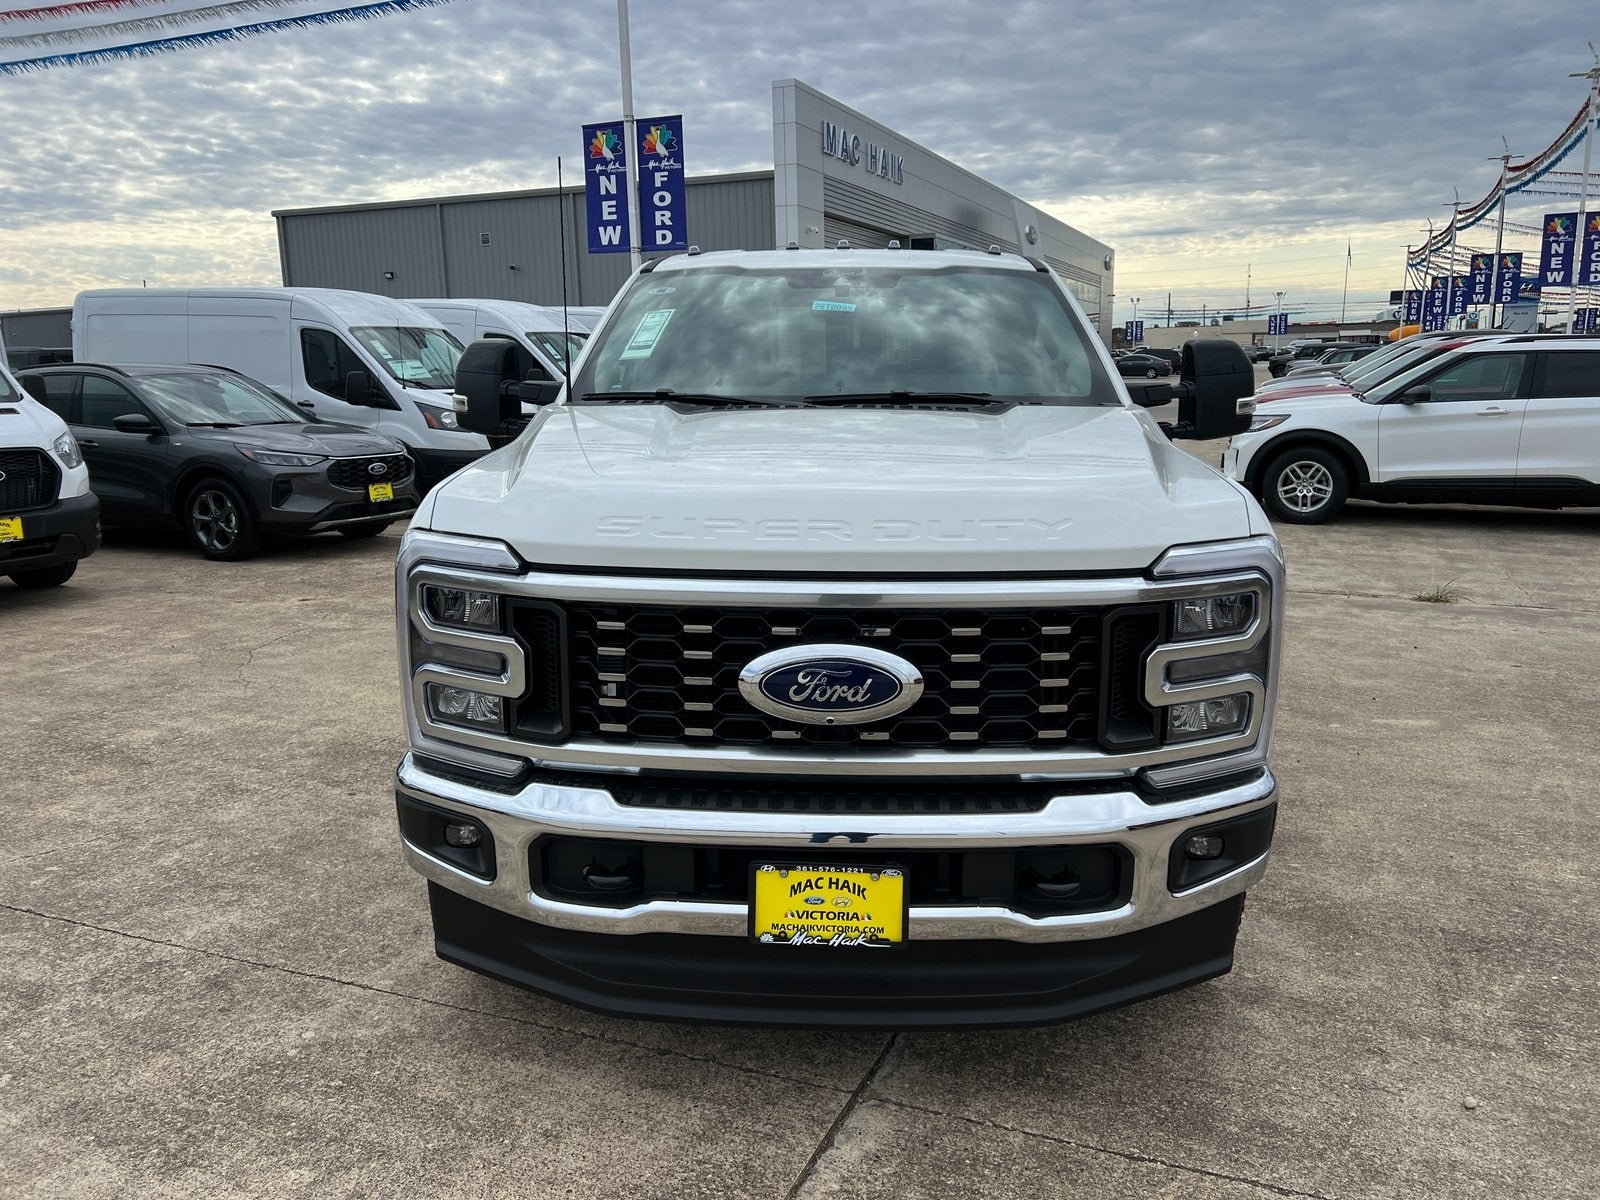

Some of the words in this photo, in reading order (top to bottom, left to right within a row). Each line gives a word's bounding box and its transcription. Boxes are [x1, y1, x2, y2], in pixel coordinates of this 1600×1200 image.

[822, 120, 861, 166] MAC
[866, 141, 905, 185] HAIK
[598, 174, 622, 246] NEW
[652, 171, 673, 245] FORD
[1546, 242, 1565, 283] NEW
[1472, 274, 1486, 303] NEW
[1502, 273, 1513, 302] FORD
[1409, 302, 1418, 321] NEW
[1433, 291, 1443, 314] NEW
[1454, 290, 1463, 313] FORD
[597, 515, 853, 542] SUPER
[872, 517, 1073, 542] DUTY
[789, 668, 873, 703] Ford
[789, 876, 824, 898] MAC
[828, 877, 867, 901] HAIK
[771, 922, 885, 934] MACHAIKVICTORIA.COM
[795, 910, 860, 922] VICTORIA
[788, 931, 827, 946] Mac
[829, 932, 870, 947] Haik
